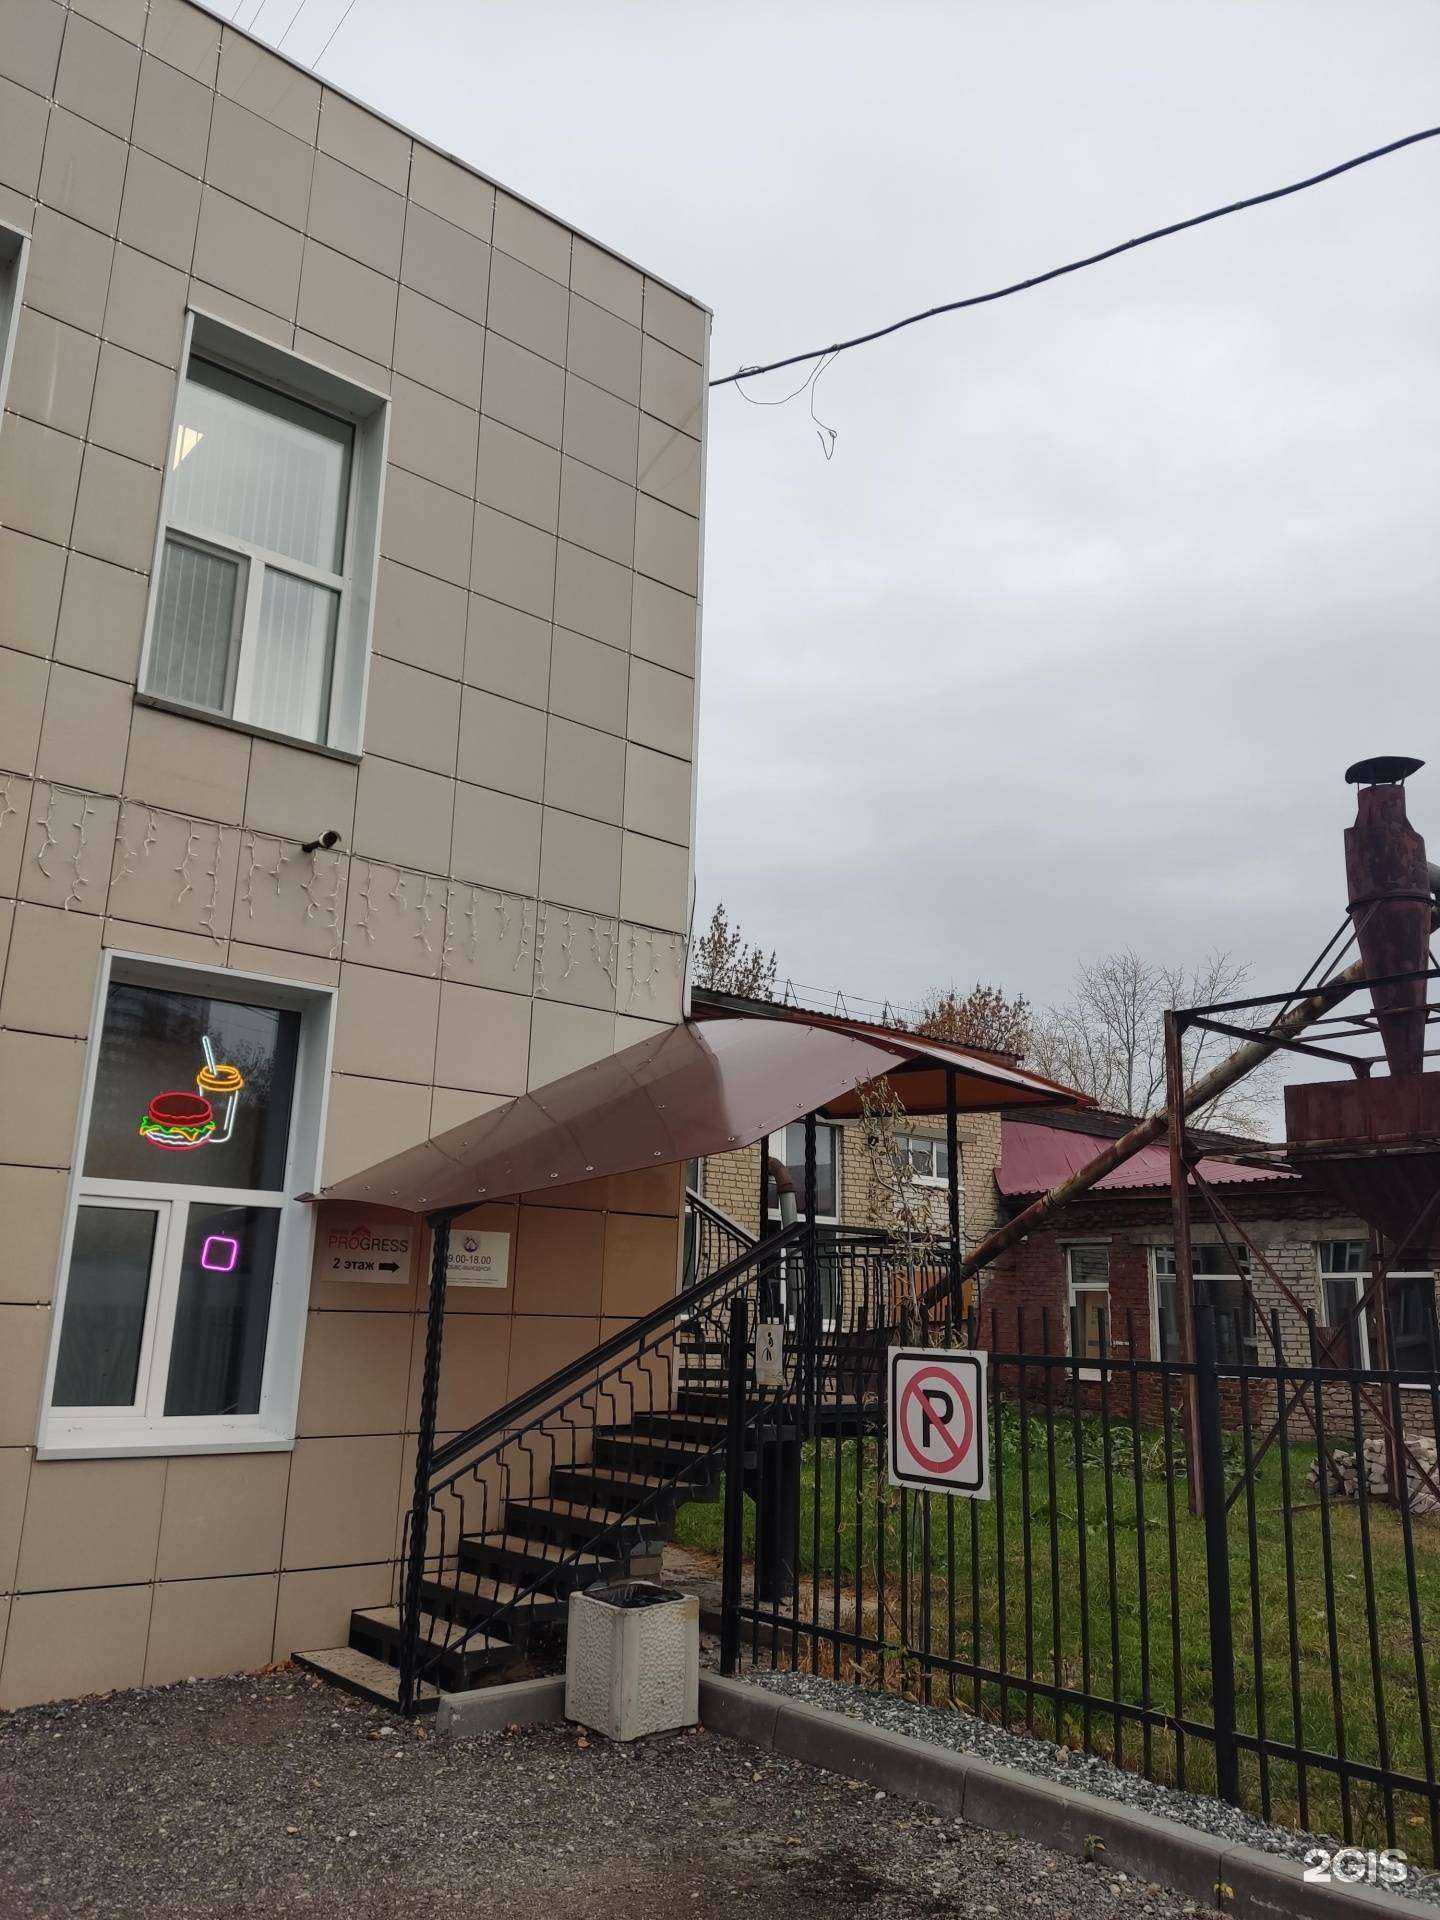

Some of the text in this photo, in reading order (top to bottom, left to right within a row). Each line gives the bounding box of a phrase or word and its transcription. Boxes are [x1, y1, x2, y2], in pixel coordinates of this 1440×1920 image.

[328, 1234, 409, 1252] PROGRESS
[332, 1257, 375, 1271] 2 этаж
[922, 1389, 954, 1448] P
